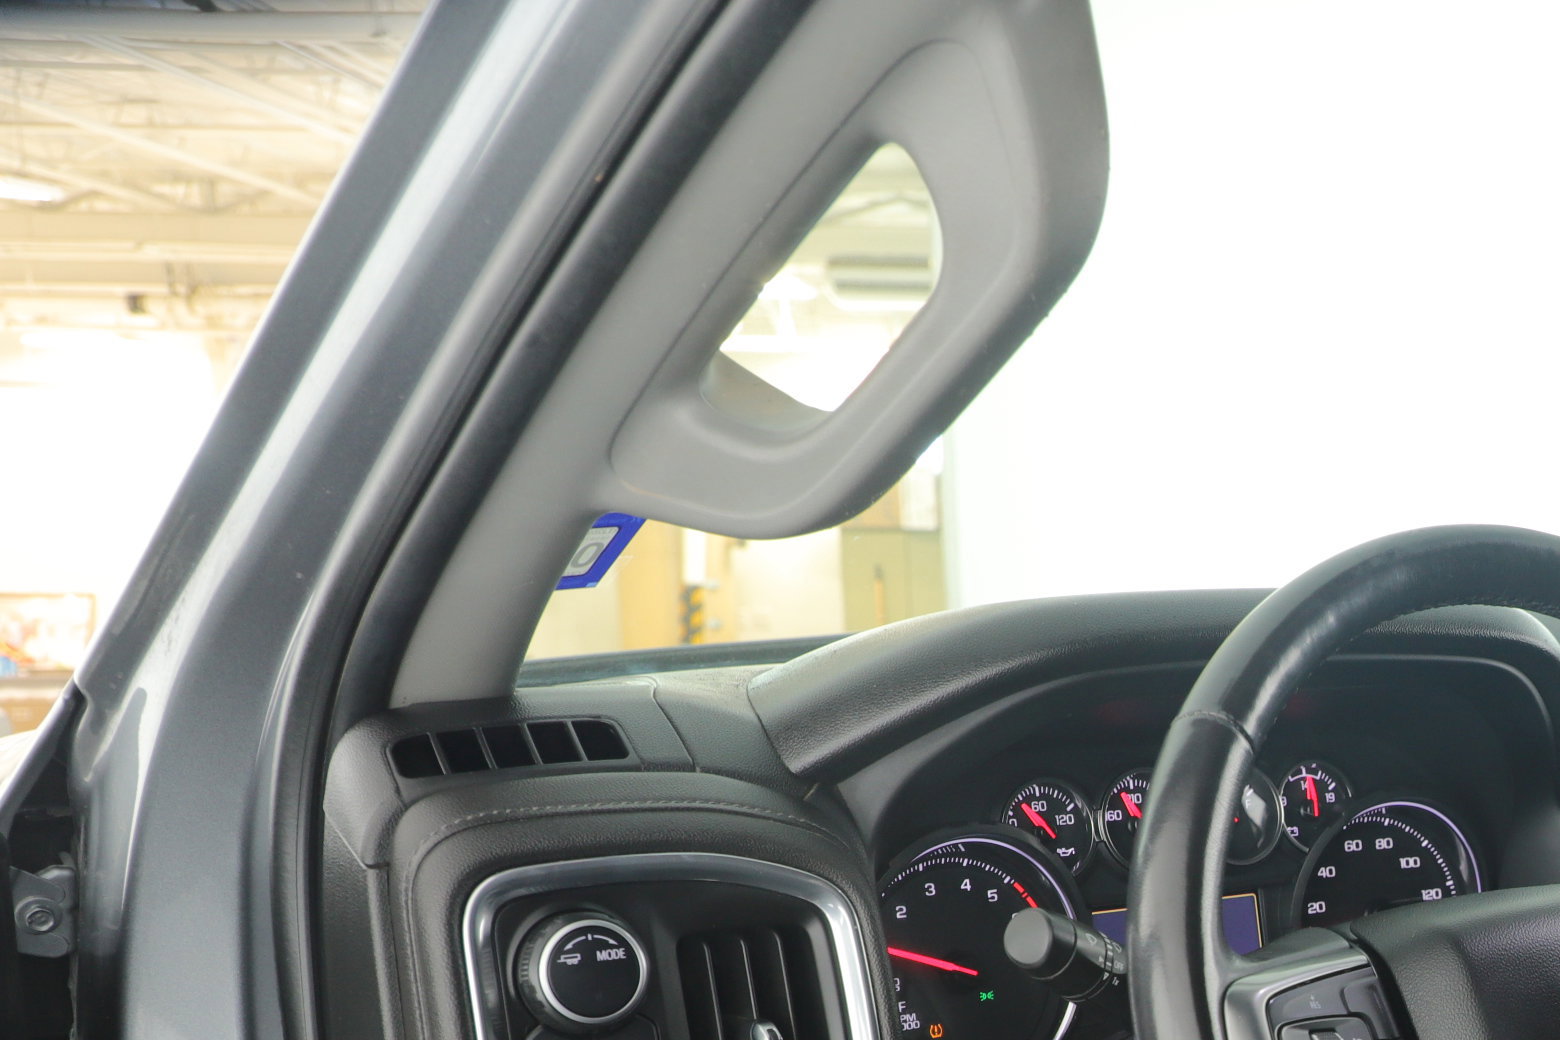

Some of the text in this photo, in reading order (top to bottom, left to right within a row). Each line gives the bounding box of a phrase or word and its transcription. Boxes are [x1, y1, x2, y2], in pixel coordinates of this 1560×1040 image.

[1126, 793, 1142, 804] 10
[1325, 792, 1335, 803] 19
[1031, 800, 1047, 812] 60
[1055, 813, 1075, 826] 120
[1344, 839, 1362, 852] 60
[1375, 837, 1393, 850] 80
[1399, 856, 1421, 869] 100
[1317, 866, 1336, 878] 40
[924, 882, 936, 896] 3
[960, 878, 972, 892] 4
[986, 888, 998, 902] 5
[1421, 887, 1442, 901] 120
[895, 905, 907, 919] 2
[1307, 901, 1326, 914] 20
[596, 948, 626, 962] MODE
[900, 1012, 917, 1024] PM
